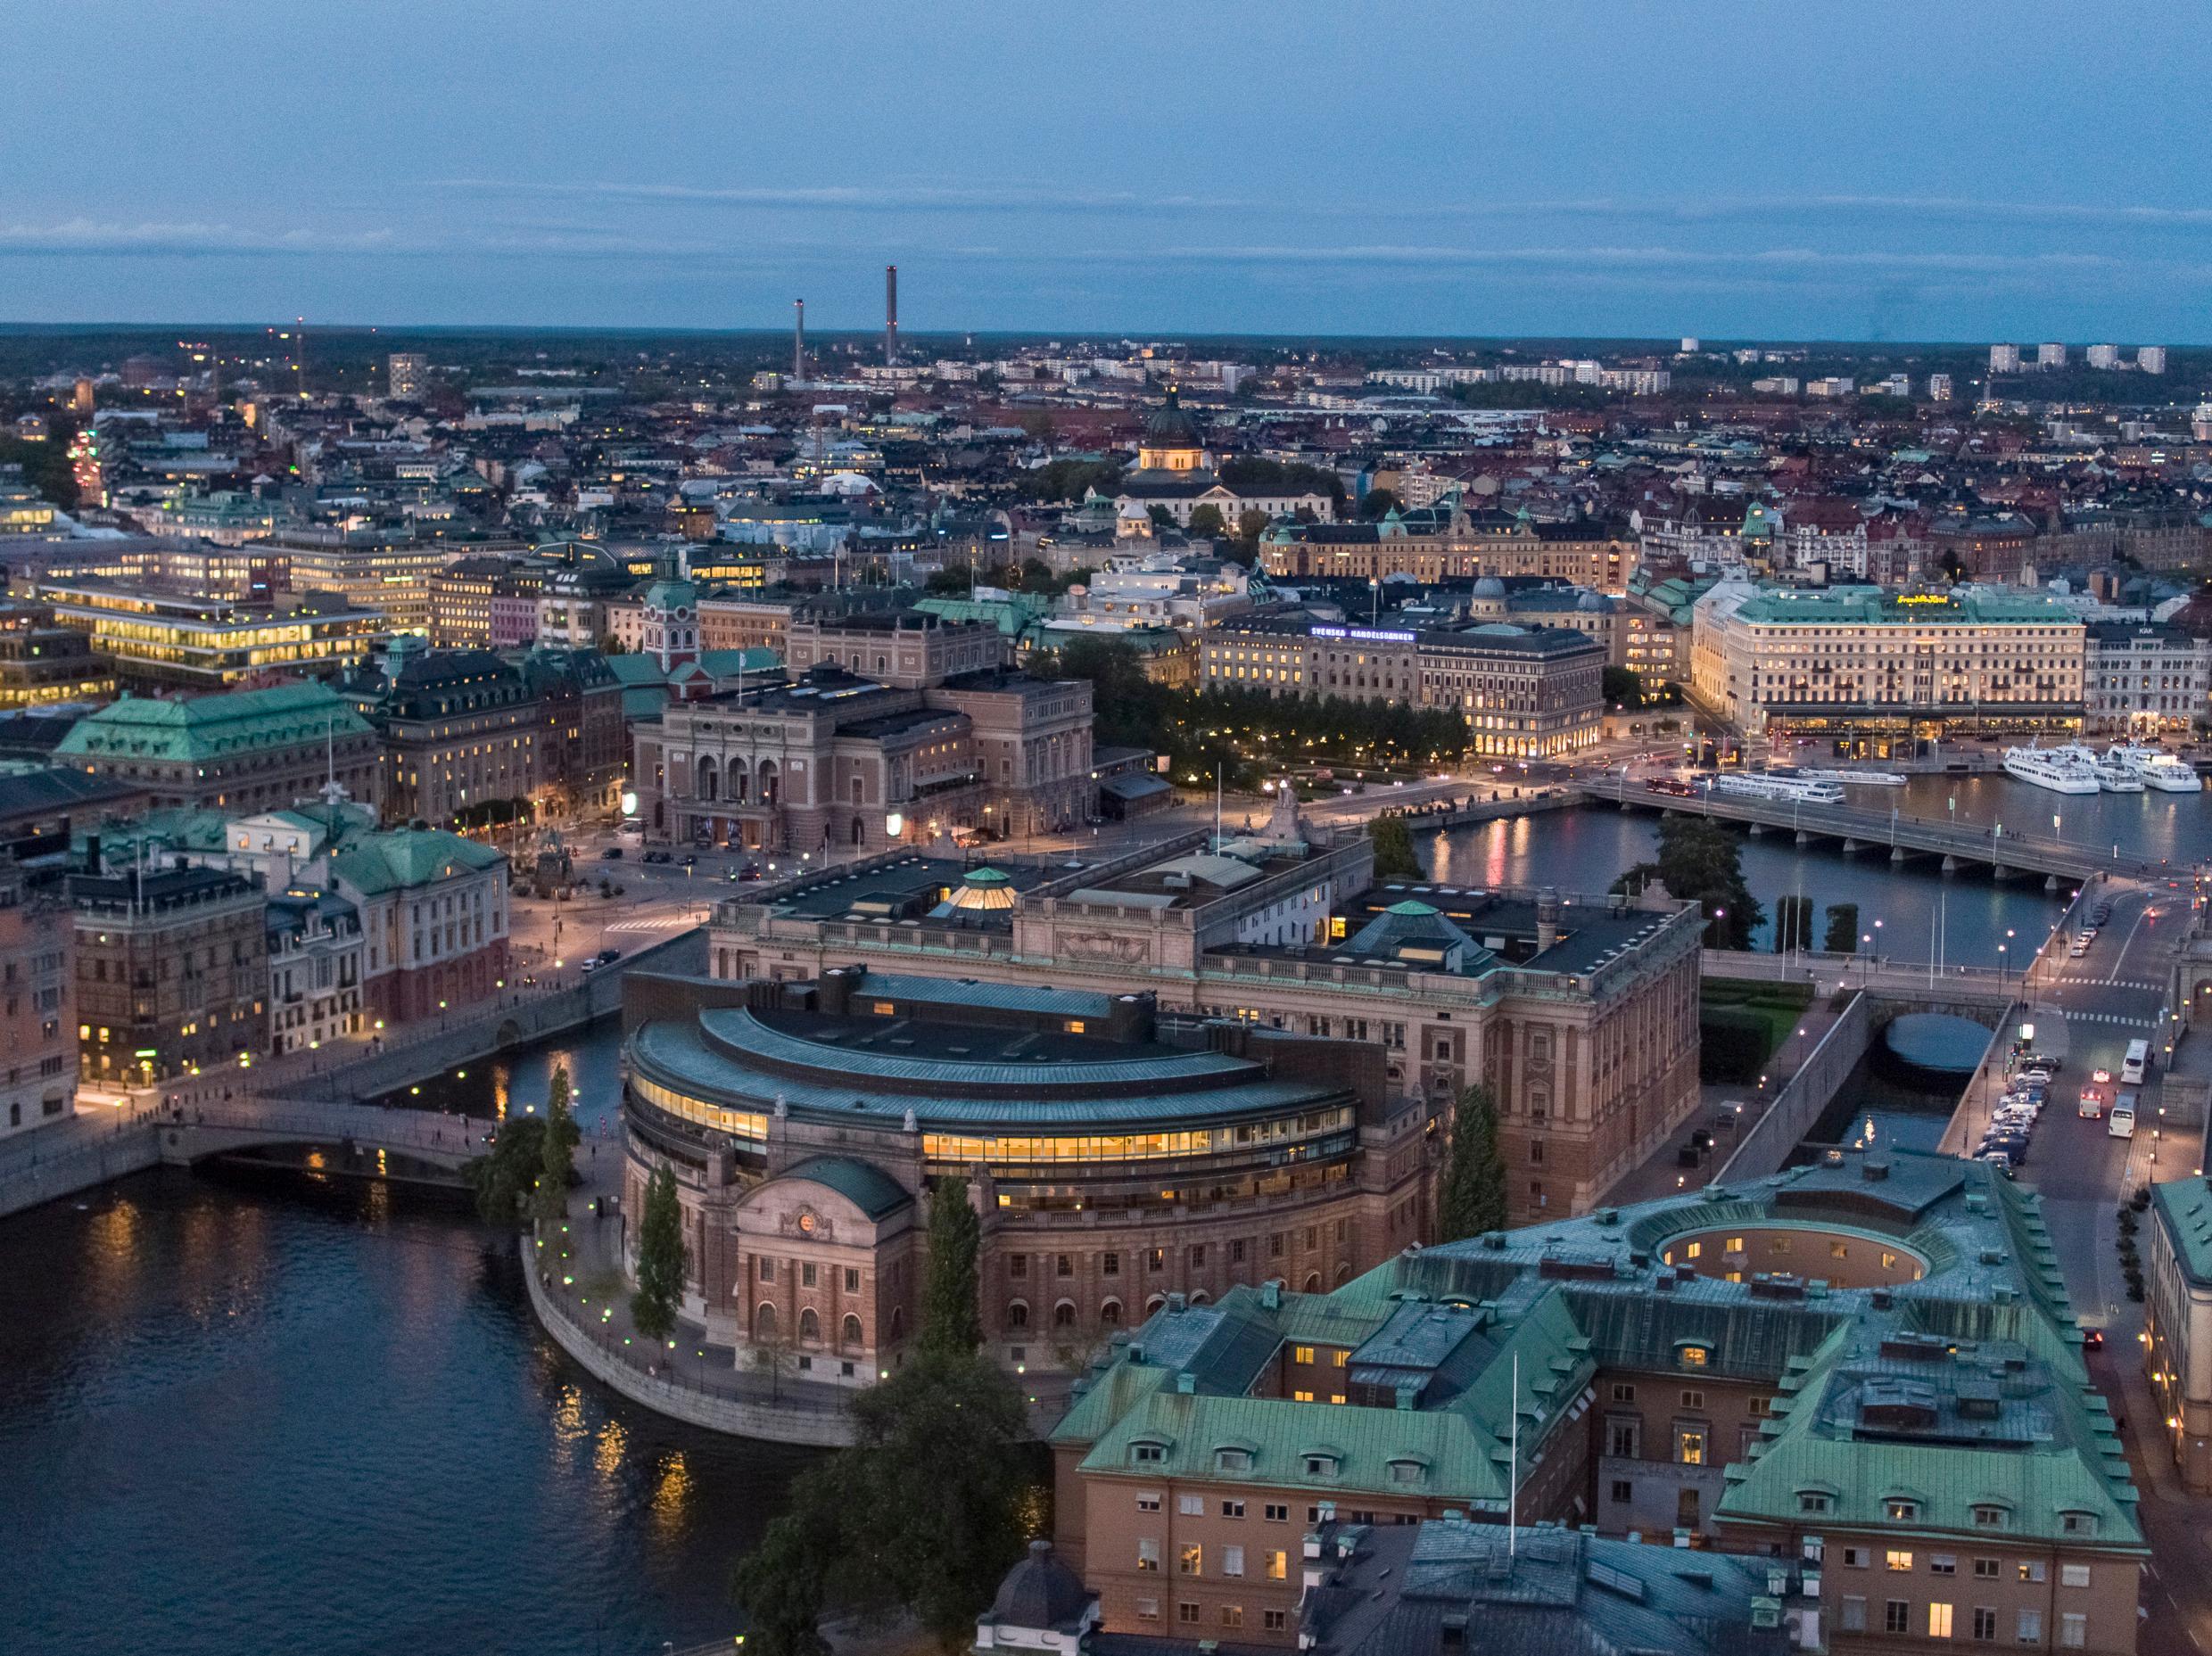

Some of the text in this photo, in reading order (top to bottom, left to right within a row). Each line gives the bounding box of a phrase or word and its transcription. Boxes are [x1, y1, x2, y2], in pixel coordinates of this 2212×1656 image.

[1897, 595, 1919, 603] Grand
[1311, 627, 1414, 641] SVENSKA HANDELSBANKEN
